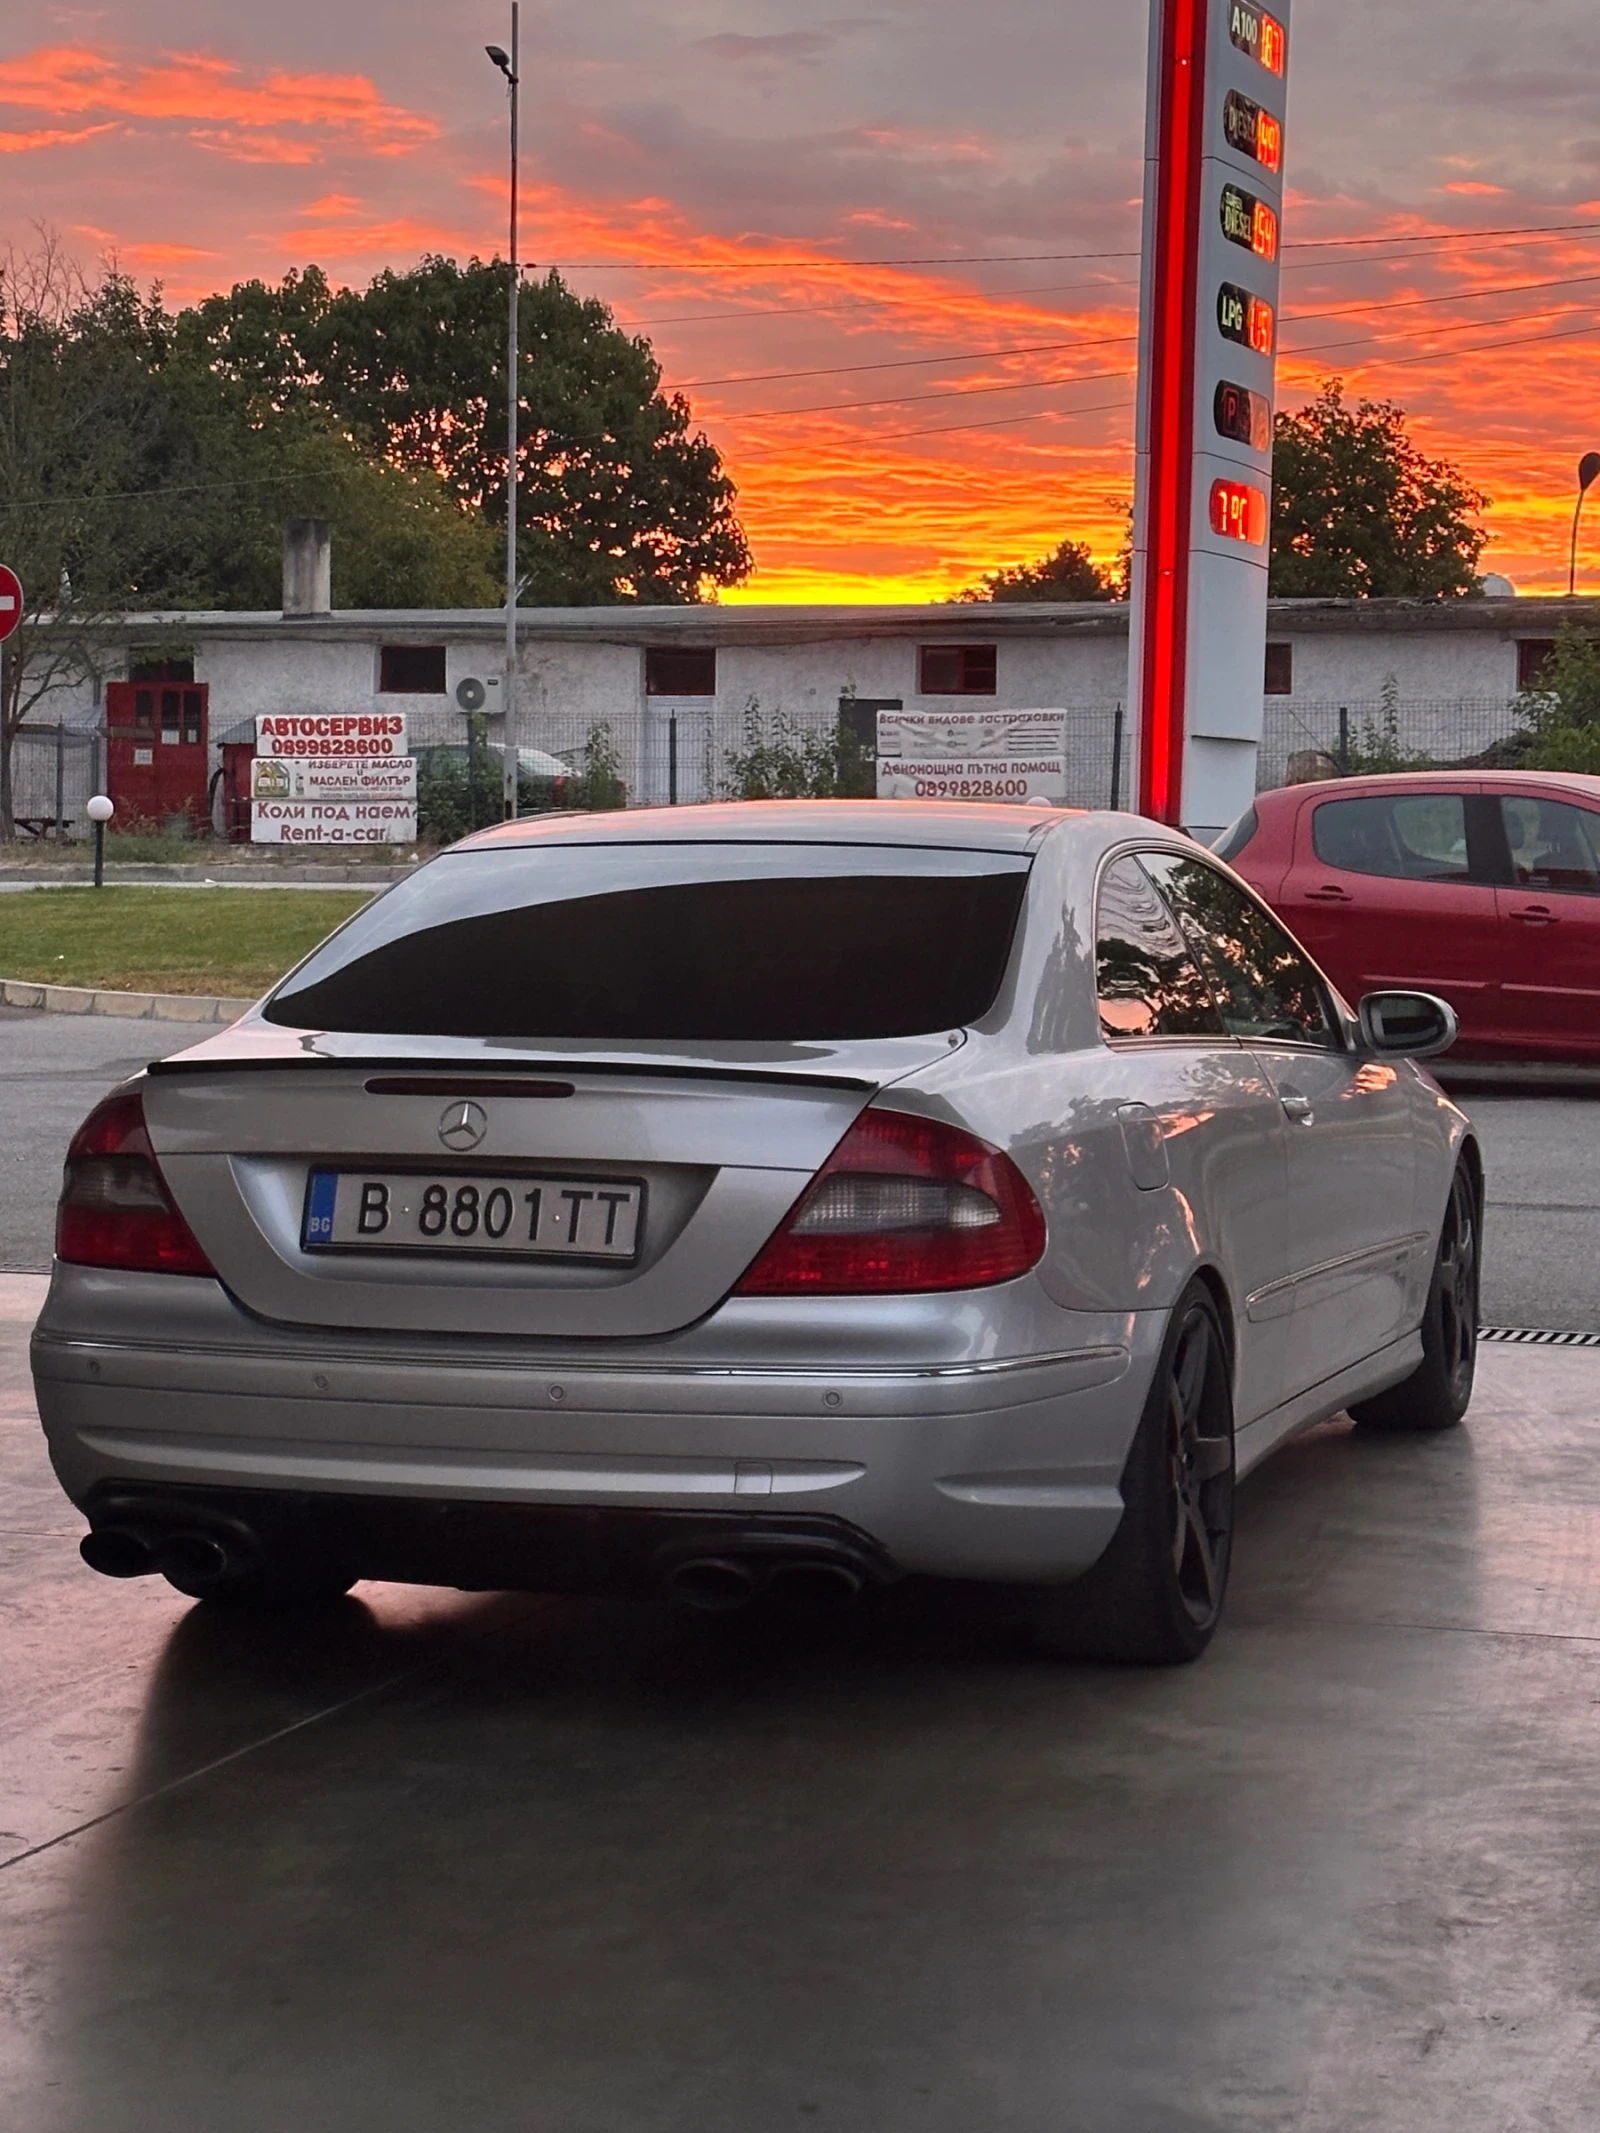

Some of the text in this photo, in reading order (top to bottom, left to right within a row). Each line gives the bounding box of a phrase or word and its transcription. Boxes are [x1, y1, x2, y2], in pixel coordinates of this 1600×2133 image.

[1232, 5, 1257, 45] A100
[1225, 205, 1252, 242] DIESEL
[1222, 295, 1243, 331] LPG
[260, 715, 403, 736] АВТОСЕРВИЗ
[879, 713, 1065, 725] Всички видове застраховки
[271, 738, 393, 755] 0899828600
[308, 760, 412, 769] ИЗБЕРЕТЕ МАСЛО
[882, 761, 1061, 776] Денонощна пътна помощ
[309, 775, 411, 786] МАСЛЕН ФИЛТЪР
[915, 779, 1027, 797] 0899828600
[258, 802, 411, 821] Коли под наем
[280, 825, 387, 841] Rent-a-car
[358, 1182, 631, 1245] B 8801 TT
[310, 1216, 331, 1233] BG
